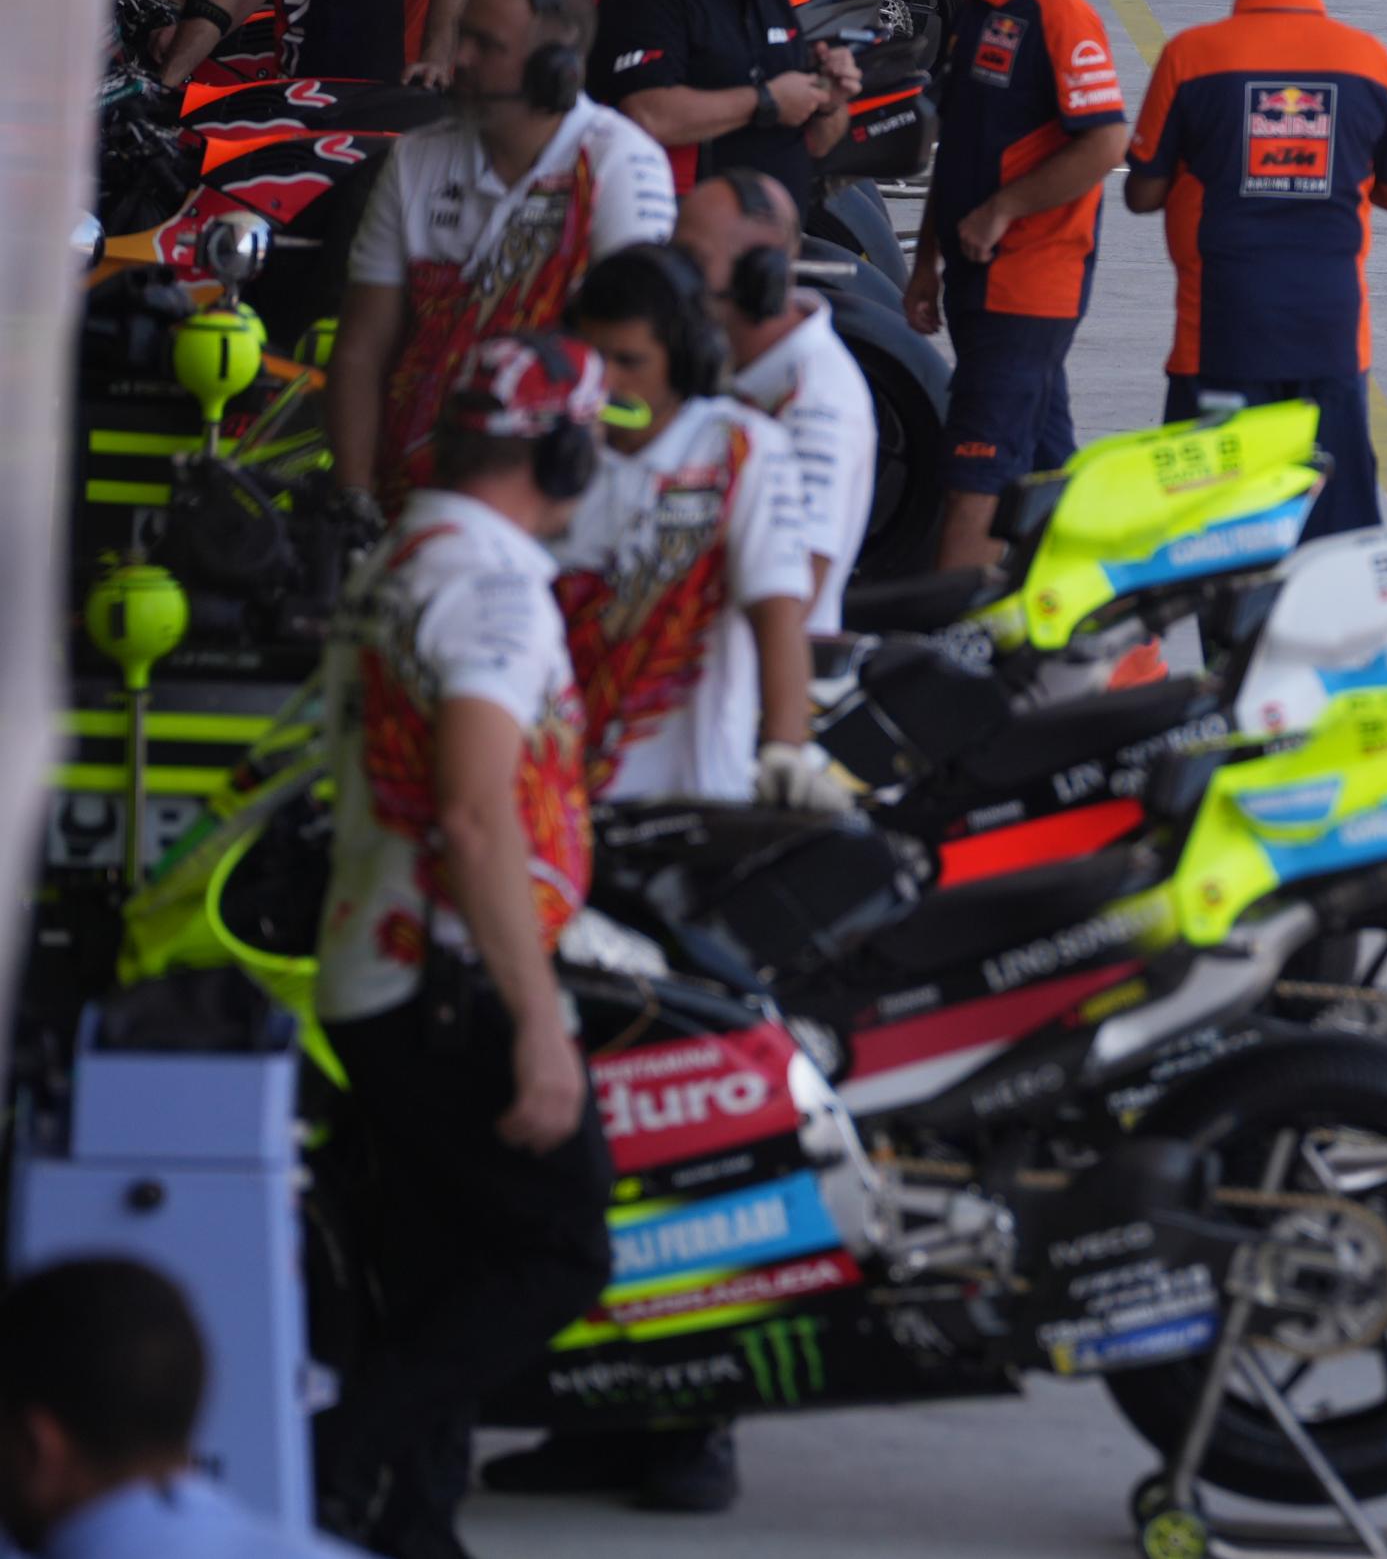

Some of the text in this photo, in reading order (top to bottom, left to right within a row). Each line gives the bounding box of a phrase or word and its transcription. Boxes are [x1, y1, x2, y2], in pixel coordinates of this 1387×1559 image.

[1250, 112, 1331, 137] Red Bull
[1260, 146, 1318, 167] KTM
